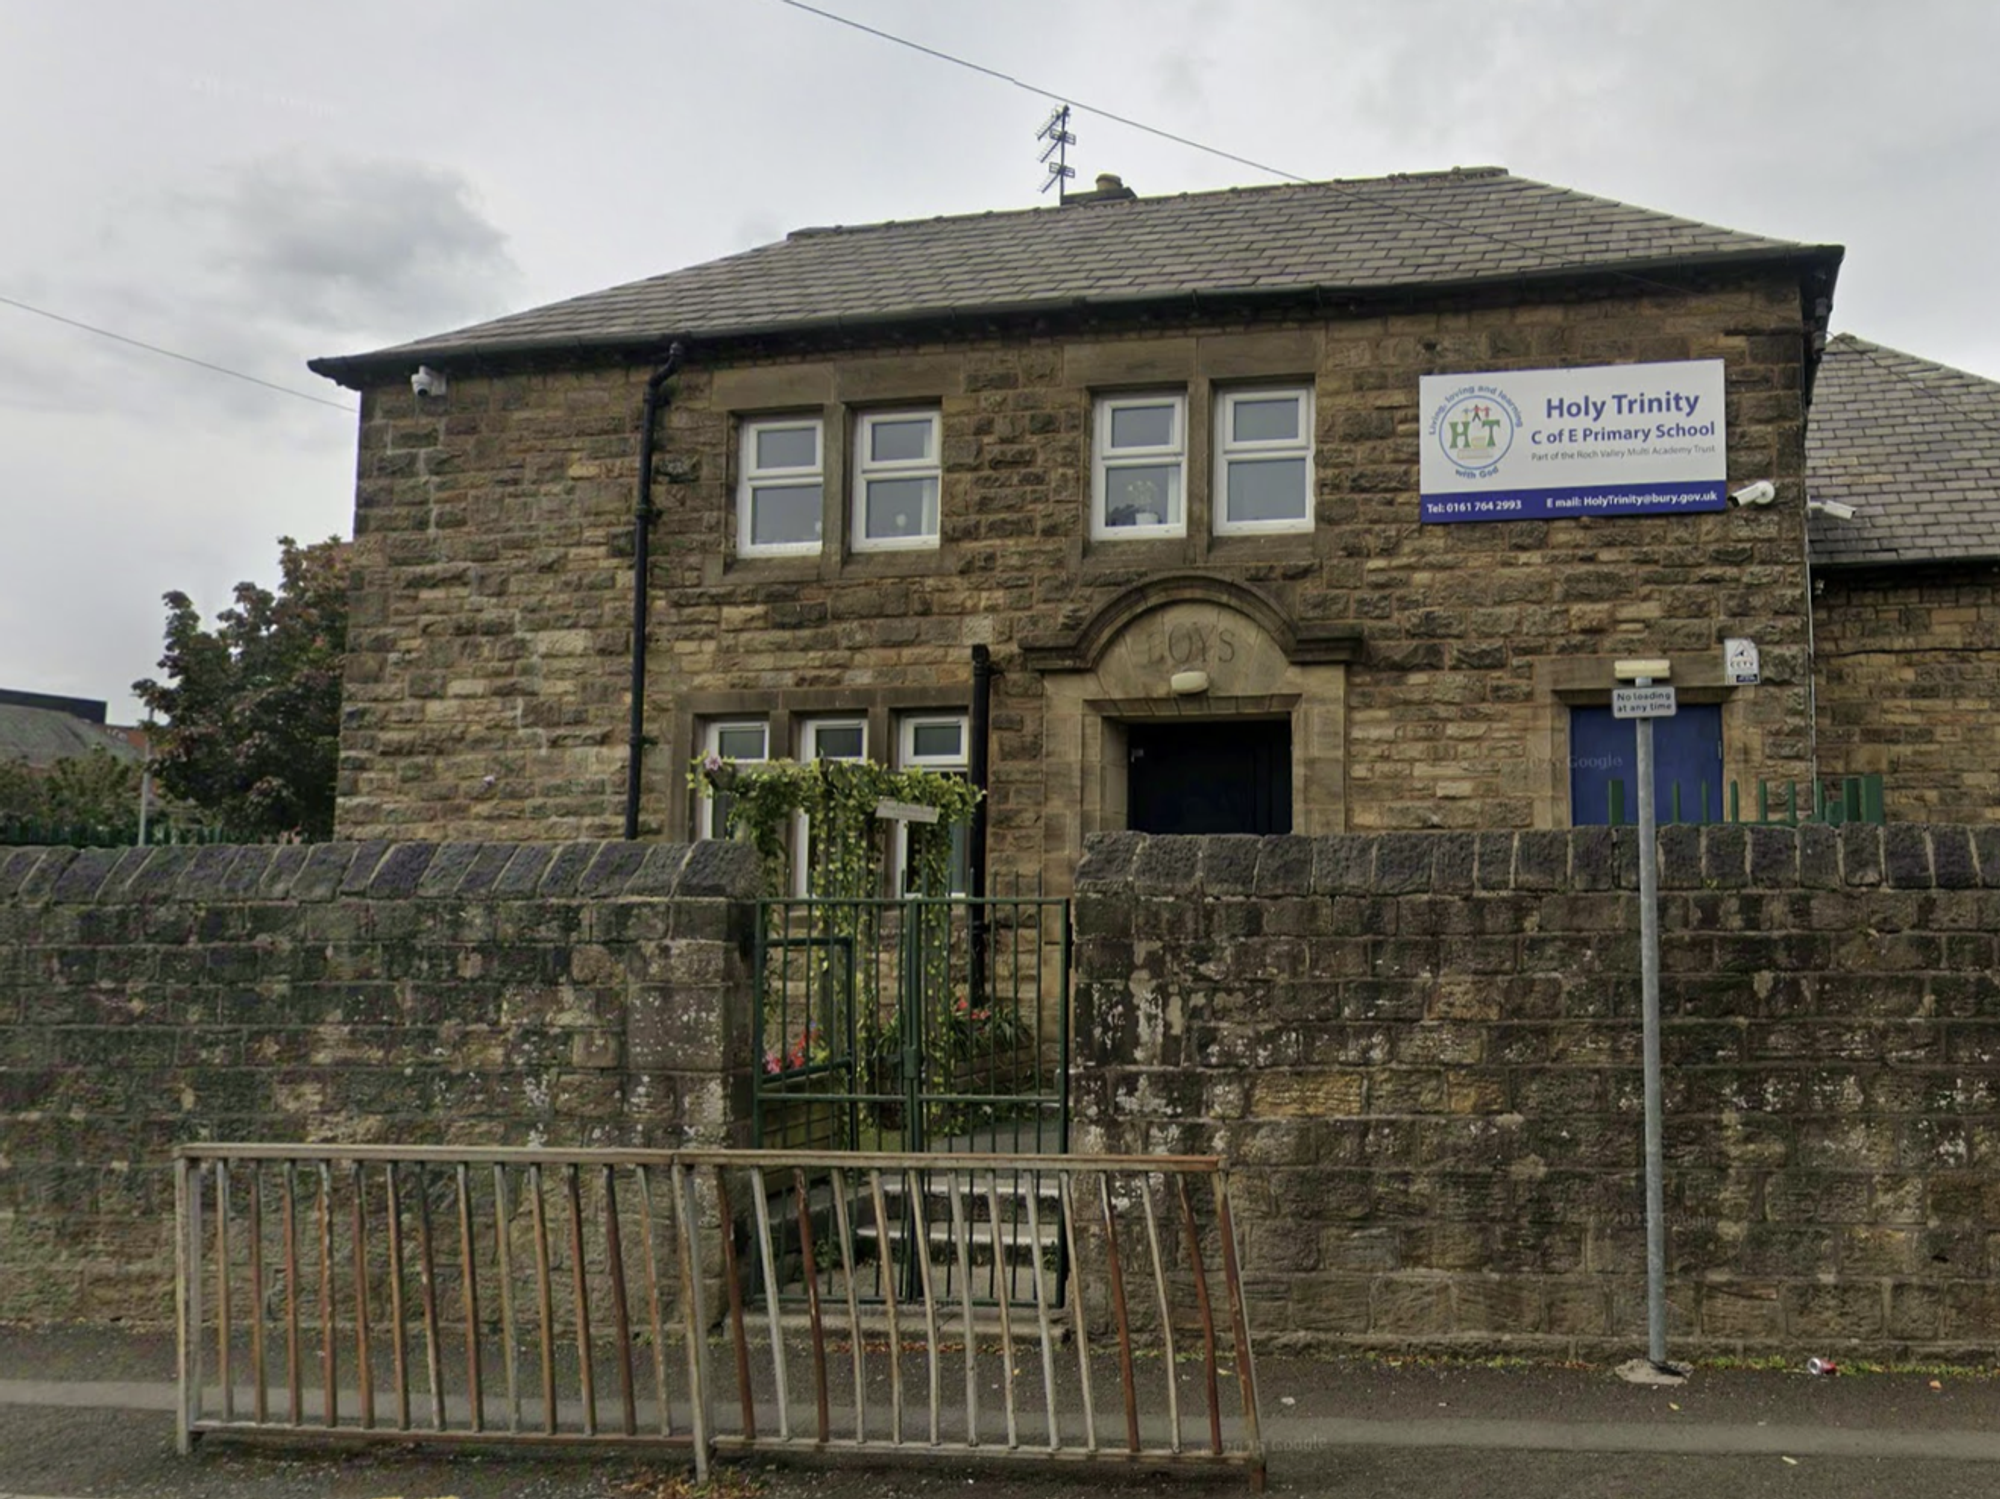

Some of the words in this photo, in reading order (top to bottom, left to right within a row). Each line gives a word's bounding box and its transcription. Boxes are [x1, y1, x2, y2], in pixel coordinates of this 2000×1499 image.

[1445, 386, 1475, 403] loving
[1477, 385, 1497, 395] and
[1498, 389, 1523, 428] learning
[1546, 395, 1606, 422] Holy
[1611, 390, 1700, 417] Trinity
[1531, 430, 1542, 445] C
[1547, 428, 1564, 444] of
[1568, 428, 1578, 443] E
[1582, 425, 1651, 443] Primary
[1655, 421, 1715, 439] School
[1531, 452, 1549, 462] Part
[1550, 451, 1560, 461] of
[1560, 451, 1576, 460] the
[1576, 450, 1599, 460] Roch
[1600, 448, 1626, 459] Valley
[1627, 446, 1650, 457] Multi
[1652, 445, 1692, 457] Academy
[1693, 444, 1716, 454] Trust
[1455, 468, 1477, 479] with
[1478, 465, 1499, 479] God
[1426, 503, 1446, 514] Tel:
[1446, 502, 1472, 513] 0161
[1474, 501, 1494, 512] 764
[1496, 499, 1522, 511] 2993
[1546, 498, 1554, 508] E
[1555, 496, 1582, 508] mail:
[1583, 491, 1718, 508] HolyTrinity@bury.gov.uk
[1617, 692, 1632, 702] No
[1633, 691, 1672, 701] loading
[1617, 703, 1627, 713] at
[1630, 704, 1647, 713] any
[1650, 702, 1672, 711] time
